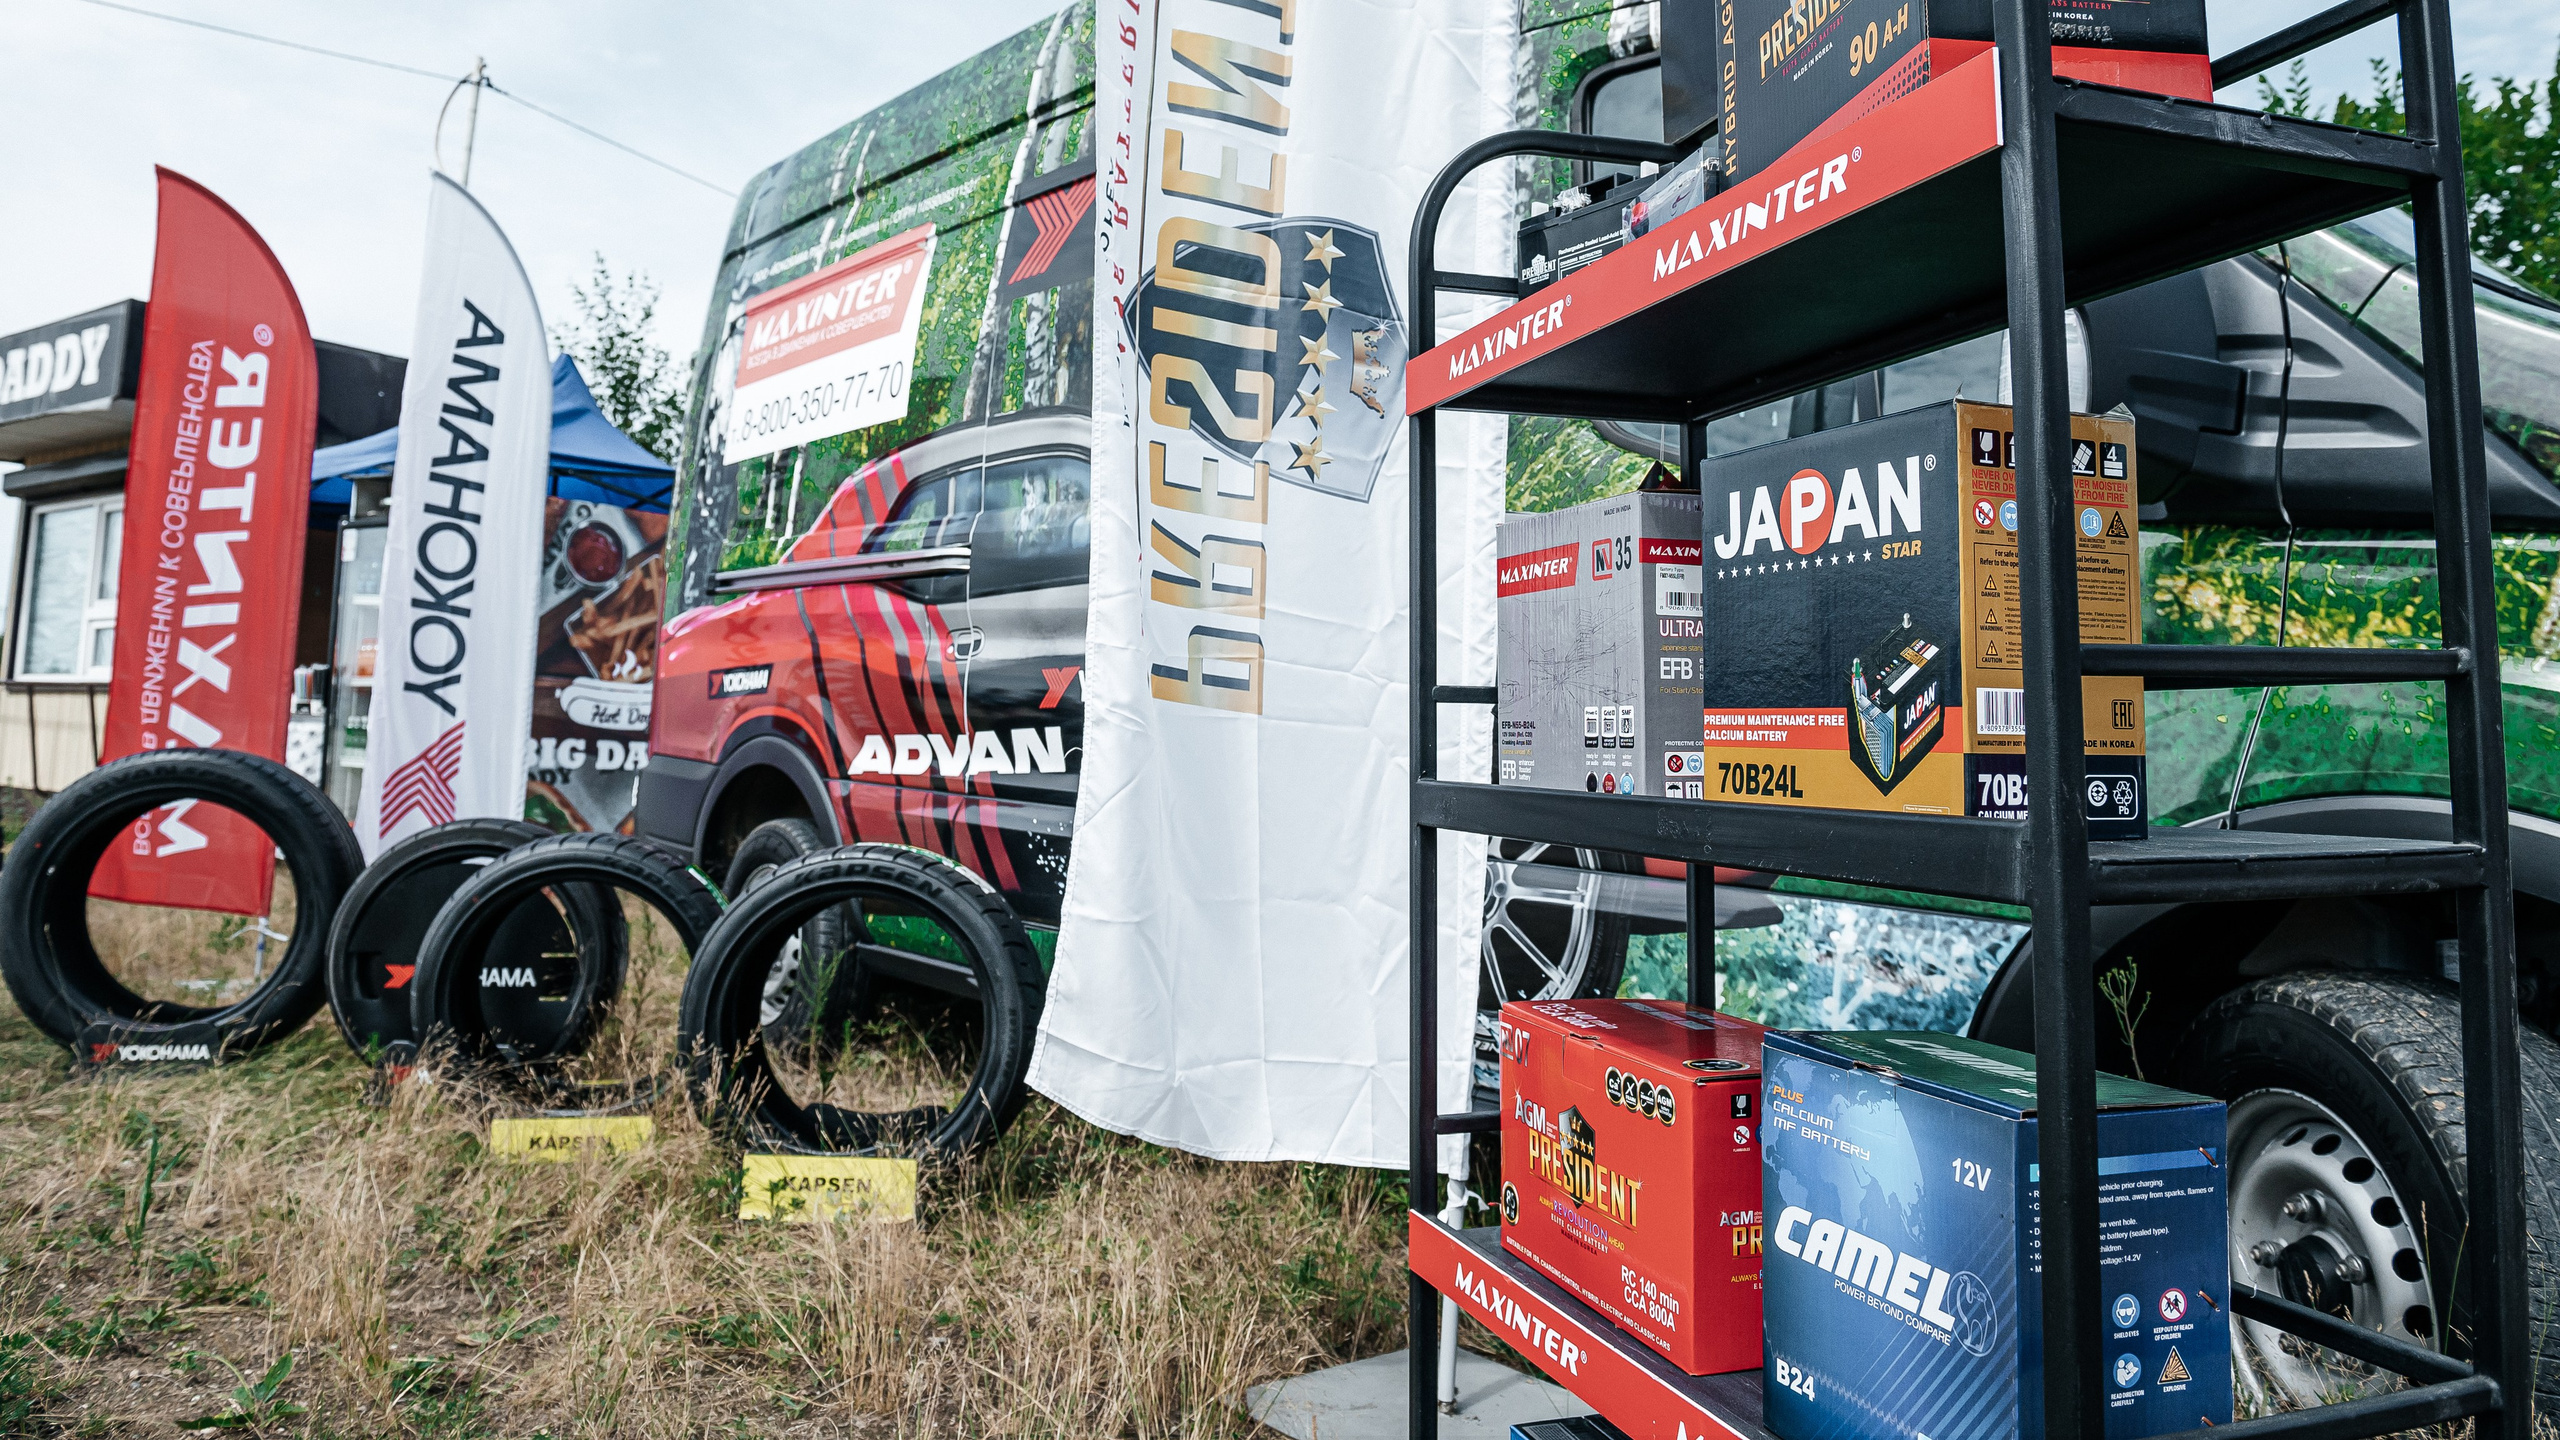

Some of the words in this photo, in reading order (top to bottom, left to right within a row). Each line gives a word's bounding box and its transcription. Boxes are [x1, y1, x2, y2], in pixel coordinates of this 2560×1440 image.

[2072, 1, 2112, 10] BATTERY
[1721, 0, 1733, 45] AG
[2064, 11, 2094, 21] KOREA
[1800, 37, 1818, 59] CLASS
[1818, 14, 1845, 44] BATTERY
[1849, 21, 1878, 78] 90
[1882, 2, 1909, 49] A-H
[1793, 64, 1808, 82] MADE
[1807, 57, 1815, 70] IN
[1814, 41, 1834, 64] KOREA
[1723, 59, 1737, 177] HYBRID
[1521, 258, 1557, 281] PRESIDENT
[741, 360, 904, 442] 8-800-350-77-70
[2106, 446, 2117, 462] 4
[1971, 468, 2001, 481] NEVER
[1971, 479, 2001, 492] NEVER
[2092, 480, 2128, 493] MOISTEN
[2081, 490, 2105, 501] FROM
[2106, 492, 2125, 502] FIRE
[1603, 506, 1617, 517] MADE
[1620, 504, 1632, 512] INDIA
[1615, 535, 1632, 571] 35
[1881, 539, 1922, 560] STAR
[1994, 549, 2003, 557] For
[2003, 550, 2015, 558] safe
[1979, 557, 1994, 566] Refer
[2000, 559, 2009, 567] the
[2083, 556, 2100, 564] before
[2107, 566, 2126, 577] battery
[1659, 619, 1704, 638] ULTRA
[1659, 657, 1693, 681] EFB
[1981, 656, 2003, 664] CAUTION
[1903, 684, 1936, 730] JAPAN
[2113, 701, 2134, 728] EAC
[1703, 714, 1746, 726] PREMIUM
[1747, 714, 1816, 727] MAINTENANCE
[1818, 714, 1845, 727] FREE
[1703, 729, 1744, 741] CALCIUM
[1745, 730, 1788, 742] BATTERY
[2099, 740, 2108, 748] IN
[2109, 740, 2135, 749] KOREA
[847, 726, 1066, 777] ADVAN
[1501, 759, 1517, 780] EFB
[1718, 762, 1804, 799] 70B24L
[2118, 805, 2130, 815] Pb
[118, 1043, 210, 1061] YOKOHAMA
[1514, 1027, 1532, 1068] 07
[1625, 1081, 1635, 1097] X
[1772, 1084, 1805, 1105] PLUS
[1657, 1094, 1672, 1108] AGM
[1514, 1094, 1546, 1135] AGM
[1772, 1101, 1834, 1131] CALCIUM
[1773, 1116, 1797, 1132] MF
[1800, 1125, 1871, 1162] BATTERY
[1528, 1127, 1642, 1228] PRESIDENT
[1951, 1157, 1992, 1193] 12V
[782, 1175, 873, 1195] KAPSEN
[2098, 1182, 2120, 1192] vehicle
[2121, 1181, 2135, 1192] prior
[2136, 1179, 2165, 1189] charging.
[2114, 1193, 2131, 1203] area,
[2131, 1193, 2149, 1203] away
[2149, 1191, 2164, 1200] from
[2164, 1188, 2187, 1199] sparks,
[2187, 1186, 2207, 1196] flames
[1553, 1199, 1608, 1243] REVOLUTION
[1607, 1236, 1625, 1251] AHEAD
[1719, 1210, 1754, 1227] AGM
[2108, 1220, 2122, 1228] vent
[2122, 1217, 2138, 1227] hole.
[1550, 1213, 1565, 1232] ELITE
[1566, 1223, 1582, 1240] CLASS
[1583, 1233, 1609, 1254] BATTERY
[2106, 1230, 2129, 1241] battery
[2129, 1228, 2152, 1239] (sealed
[2152, 1226, 2170, 1238] type).
[1774, 1205, 1956, 1332] CAMEL
[1730, 1273, 1758, 1284] ALWAYS
[1506, 1235, 1524, 1254] SUITABLE
[1540, 1259, 1561, 1280] CHARGING
[1600, 1300, 1623, 1321] ELECTRIC
[1623, 1315, 1634, 1327] AND
[1633, 1322, 1656, 1343] CLASSIC
[1655, 1336, 1671, 1352] CARS
[1621, 1264, 1636, 1288] RC
[1639, 1276, 1657, 1300] 140
[1659, 1290, 1680, 1315] min
[1623, 1285, 1647, 1315] CCA
[1649, 1301, 1676, 1333] 800A
[1834, 1278, 1866, 1303] POWER
[1866, 1294, 1904, 1322] BEYOND
[1905, 1314, 1952, 1347] COMPARE
[2113, 1331, 2129, 1340] SHIELD
[2128, 1330, 2140, 1338] EYES
[2153, 1326, 2164, 1334] KEEP
[2163, 1325, 2173, 1333] OUT
[2179, 1323, 2194, 1331] REACH
[2154, 1334, 2160, 1342] OF
[2160, 1332, 2182, 1341] CHILDREN
[1776, 1357, 1816, 1402] B24
[2163, 1384, 2187, 1393] EXPLOSIVE
[2110, 1392, 2123, 1401] READ
[2122, 1389, 2145, 1399] DIRECTION
[2110, 1398, 2135, 1408] CAREFULLY
